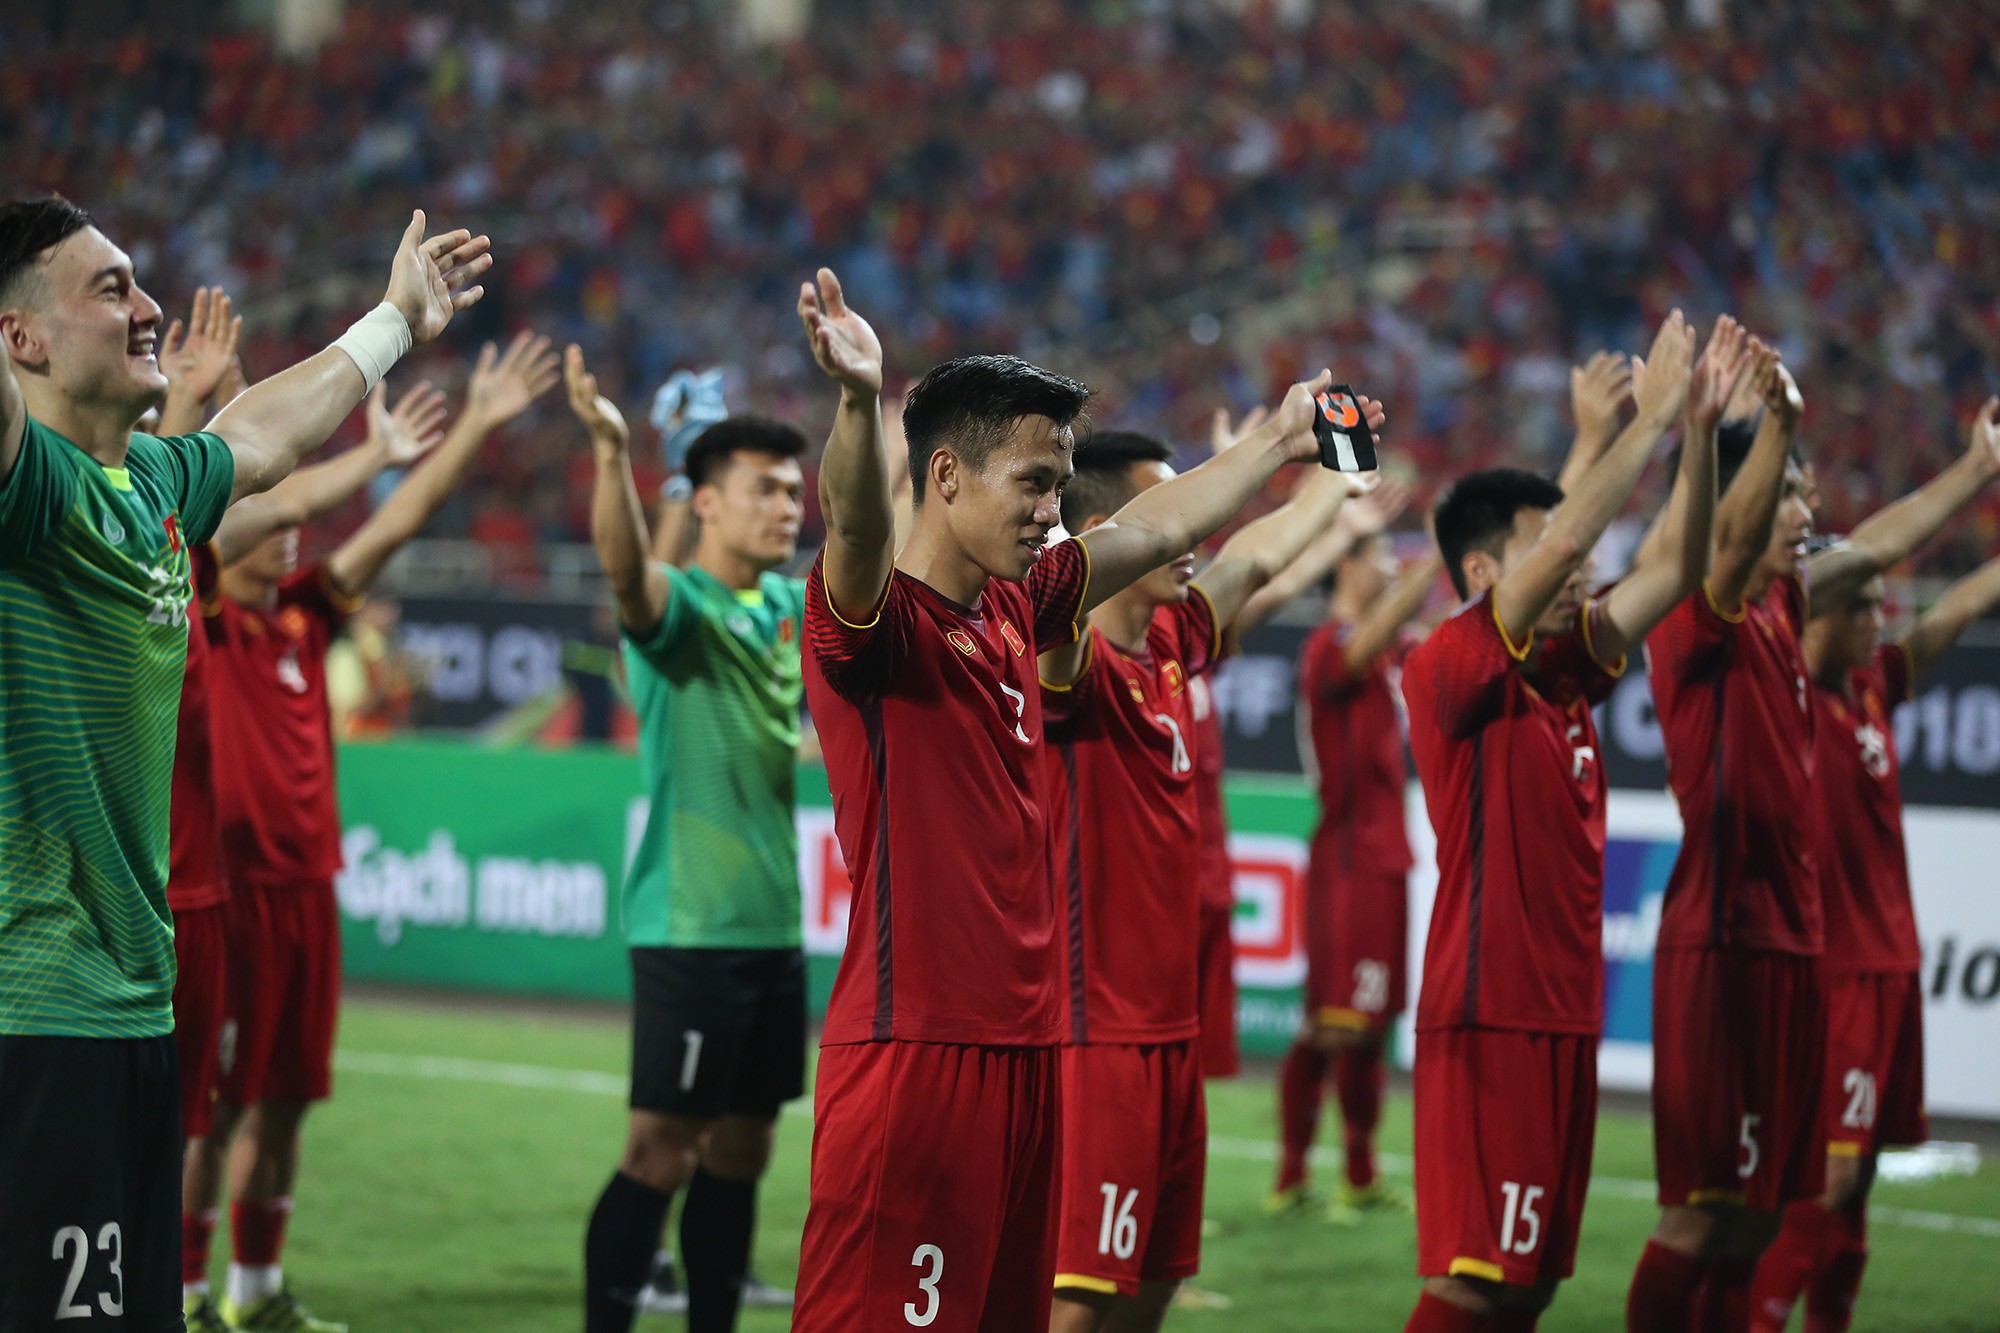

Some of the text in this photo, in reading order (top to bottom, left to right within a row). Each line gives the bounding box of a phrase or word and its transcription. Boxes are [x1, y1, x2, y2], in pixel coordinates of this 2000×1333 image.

[474, 855, 606, 937] men
[679, 1028, 704, 1093] 1
[1737, 1112, 1761, 1178] 5
[1098, 1181, 1140, 1260] 16
[1501, 1181, 1545, 1255] 15
[52, 1221, 124, 1320] 23
[904, 1243, 944, 1328] 3
